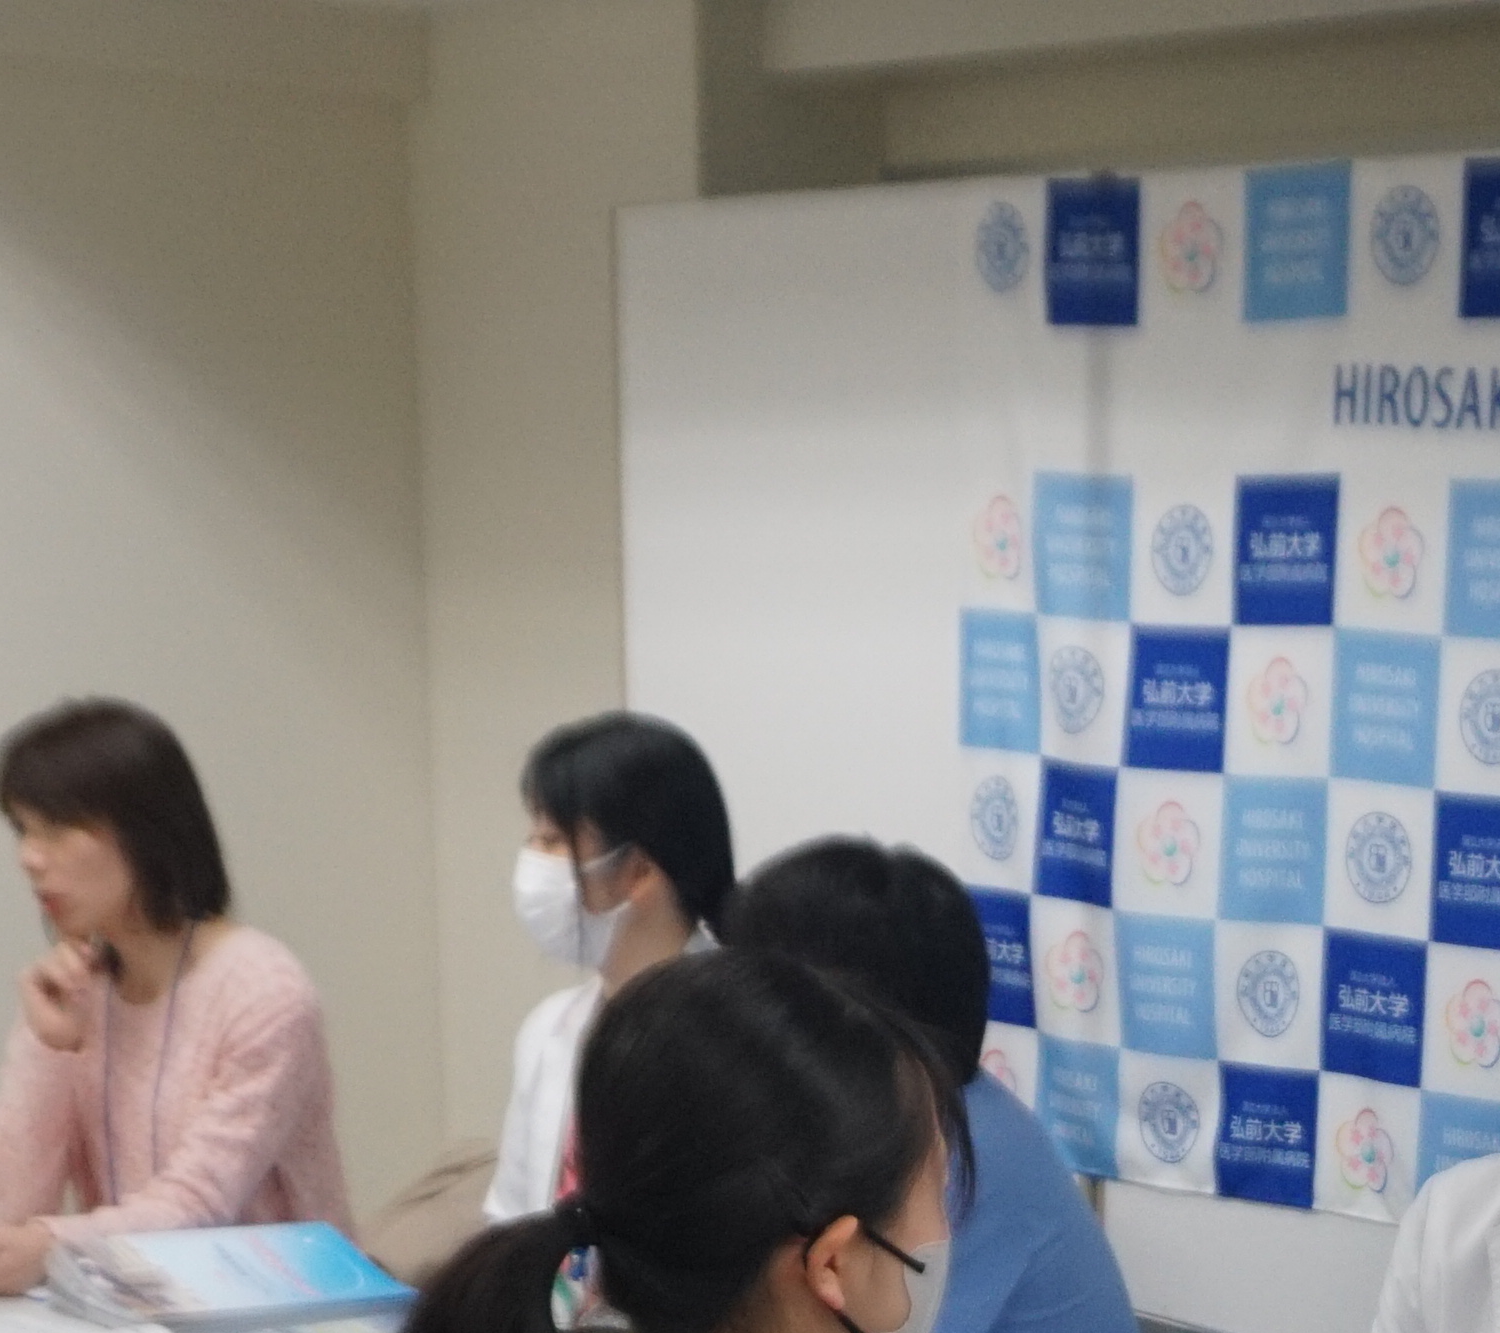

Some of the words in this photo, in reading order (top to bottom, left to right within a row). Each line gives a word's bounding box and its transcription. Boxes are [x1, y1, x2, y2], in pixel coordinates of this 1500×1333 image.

[1142, 678, 1212, 706] 弘前大学
[1338, 985, 1409, 1016] 弘前大学
[1230, 1114, 1302, 1144] 弘前大学
